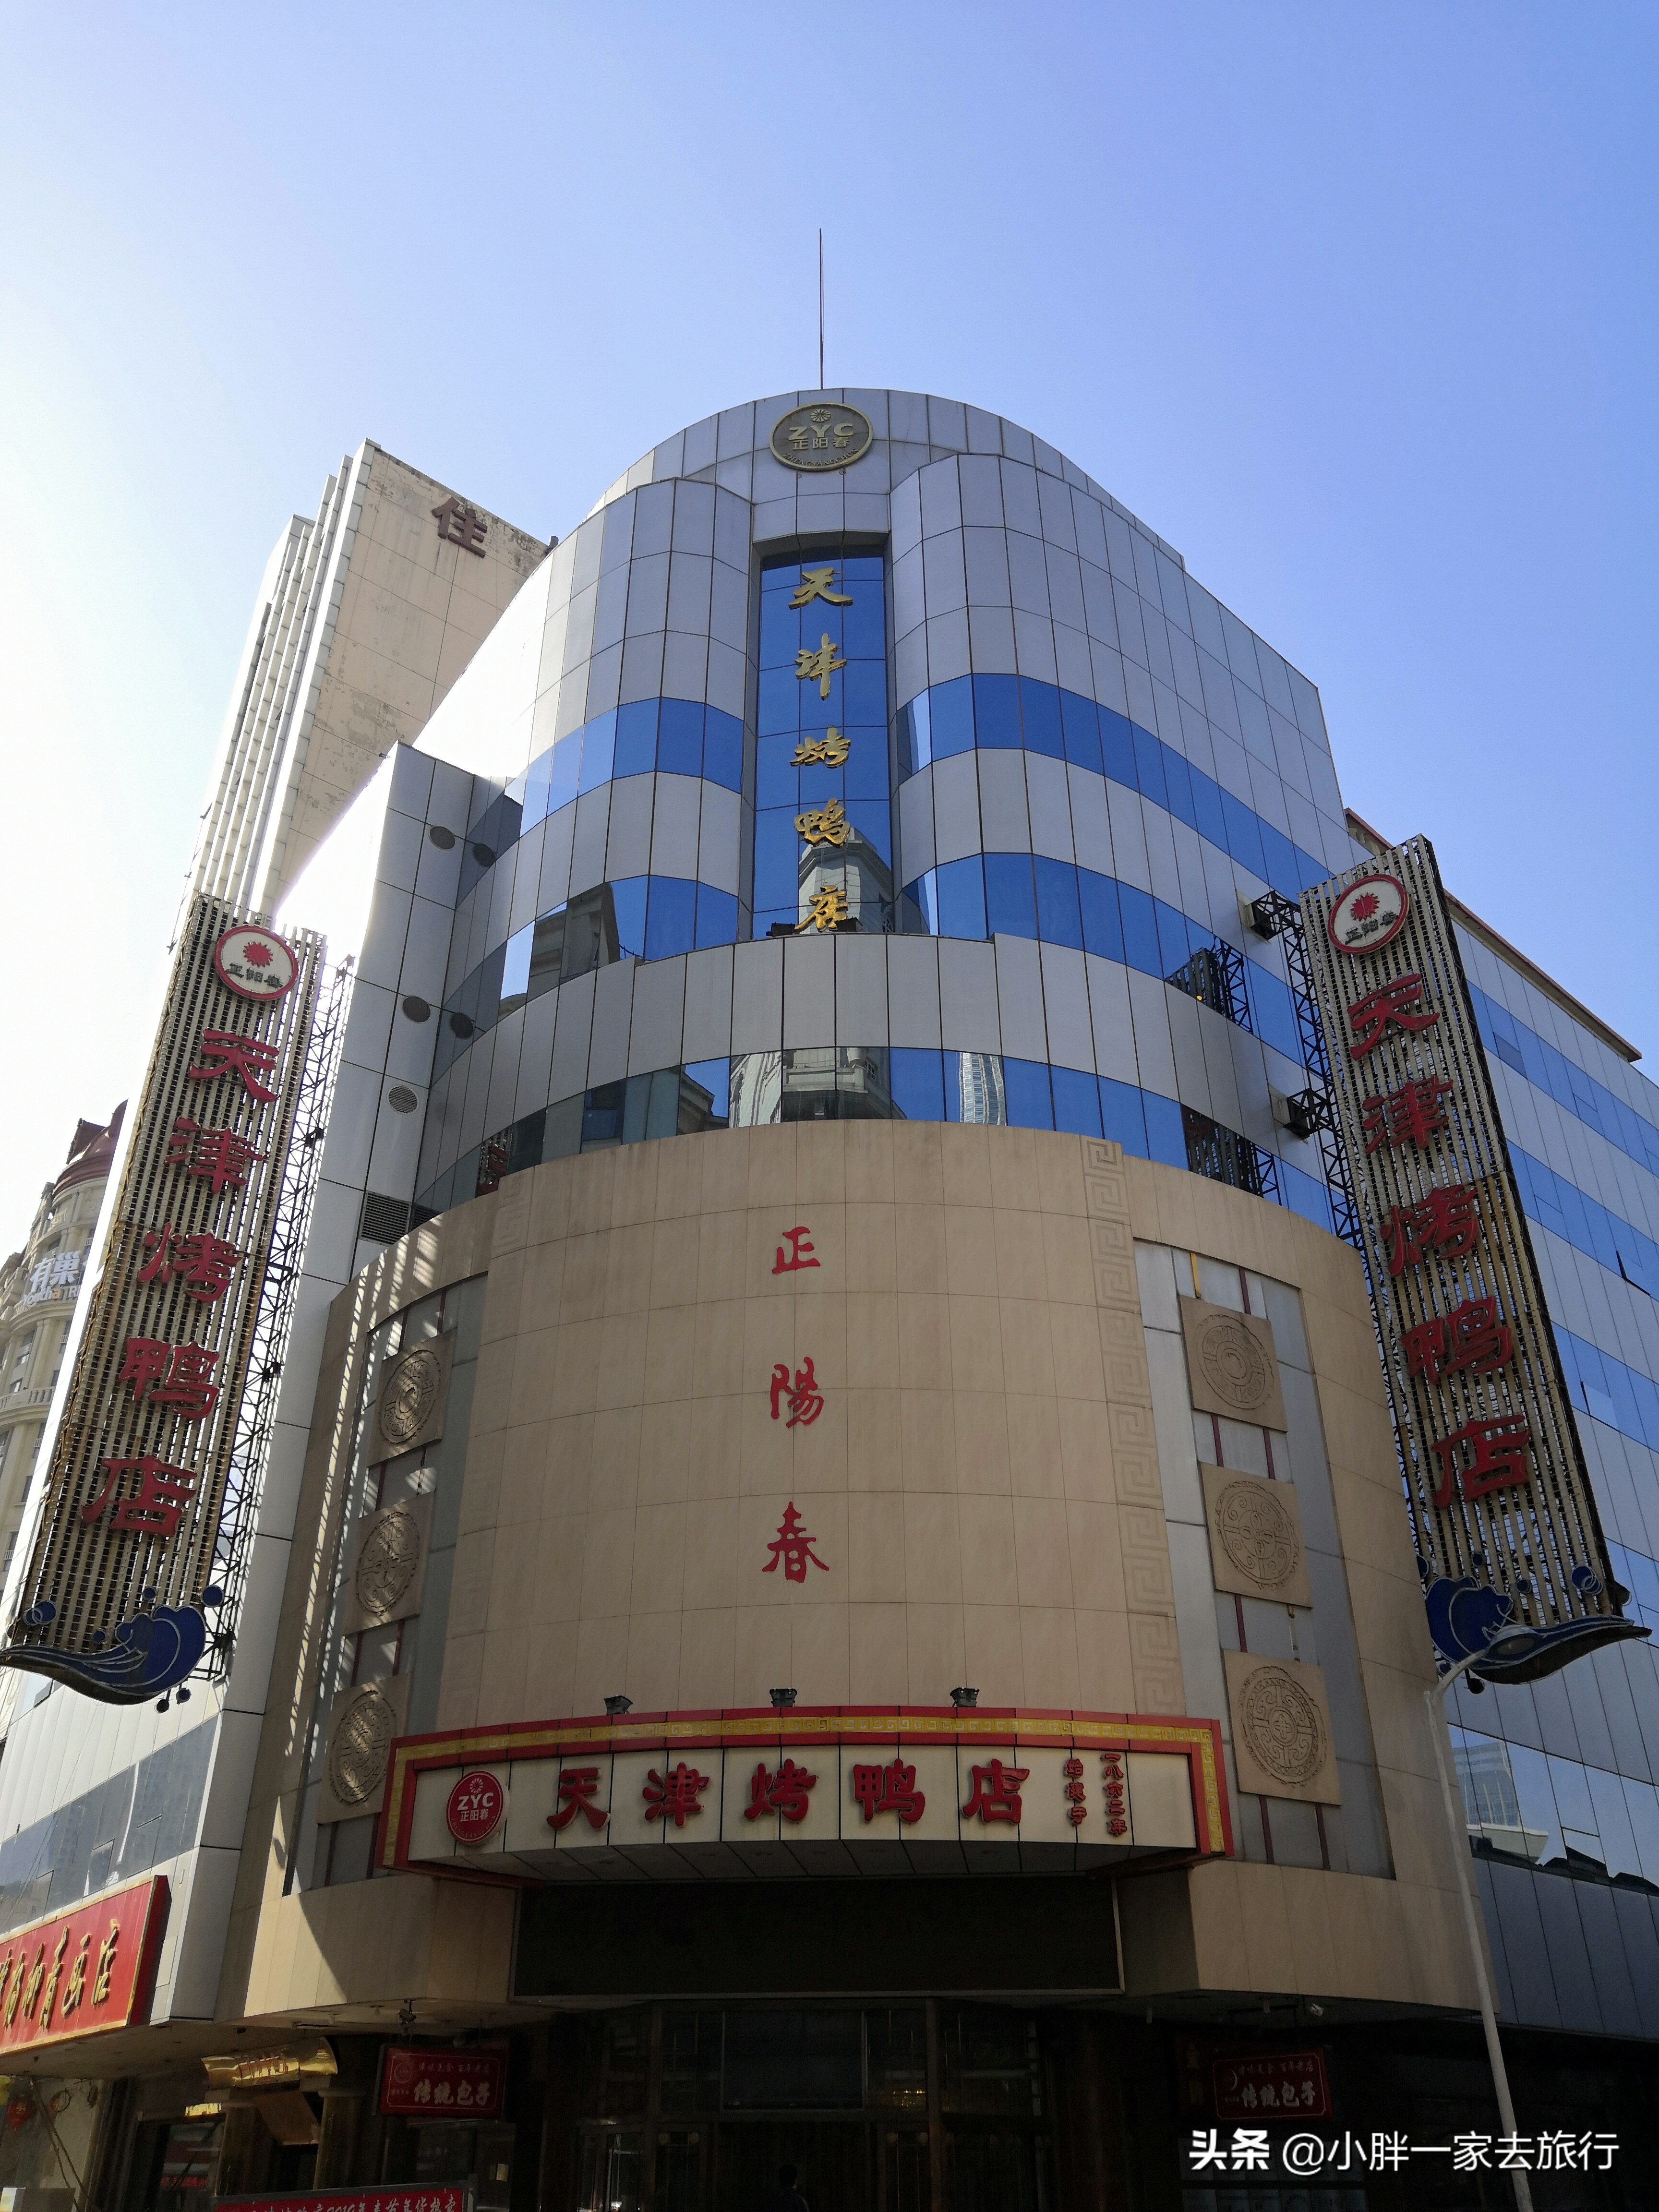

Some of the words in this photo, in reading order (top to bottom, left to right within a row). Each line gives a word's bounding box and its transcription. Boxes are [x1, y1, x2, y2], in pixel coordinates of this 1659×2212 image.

[788, 422, 854, 441] ZYC
[792, 437, 850, 450] 正阳春
[432, 497, 488, 558] 住
[788, 567, 854, 932] 天津烤鸭店
[1348, 974, 1531, 1509] 天津烤鸭店
[81, 1028, 280, 1539] 天津烤鸭店
[457, 1792, 493, 1811] ZYC
[460, 1809, 489, 1822] 正阳春
[547, 1758, 1030, 1828] 天津烤鸭店
[1104, 1753, 1128, 1835] 一八六二年
